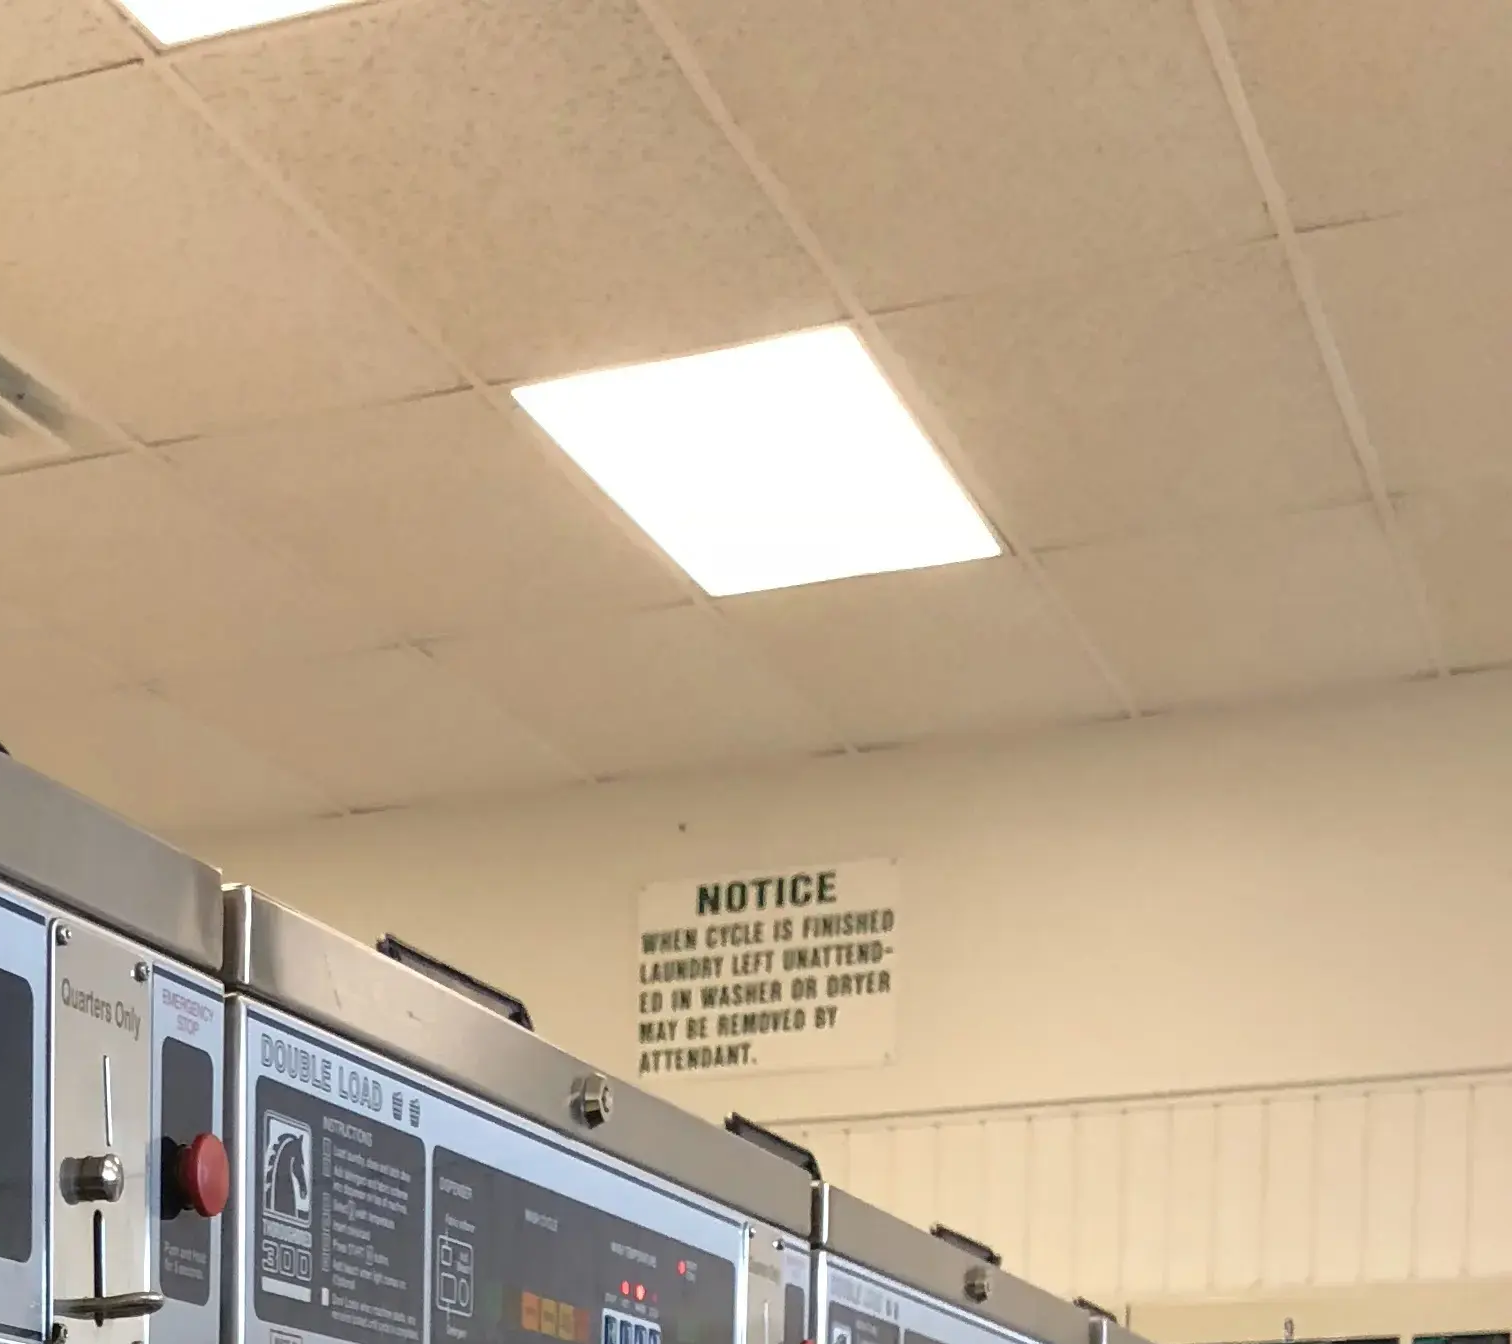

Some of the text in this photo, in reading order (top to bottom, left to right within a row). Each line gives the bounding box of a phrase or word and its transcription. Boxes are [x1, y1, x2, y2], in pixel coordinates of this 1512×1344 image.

[696, 869, 837, 917] NOTICE
[641, 907, 895, 954] WHEN CYCLE IS FINISHED
[639, 939, 894, 985] LAUNDRY LEFT UNATTEND-
[61, 977, 142, 1041] Quarters Only
[162, 988, 213, 1023] EMERGENCY
[639, 969, 891, 1014] ED IN WASHER OR DRYER
[176, 1014, 199, 1037] STOP
[639, 1005, 838, 1043] MAY BE REMOVED BY
[260, 1033, 383, 1112] DOUBLE LOAD
[639, 1042, 757, 1075] ATTENDANT.
